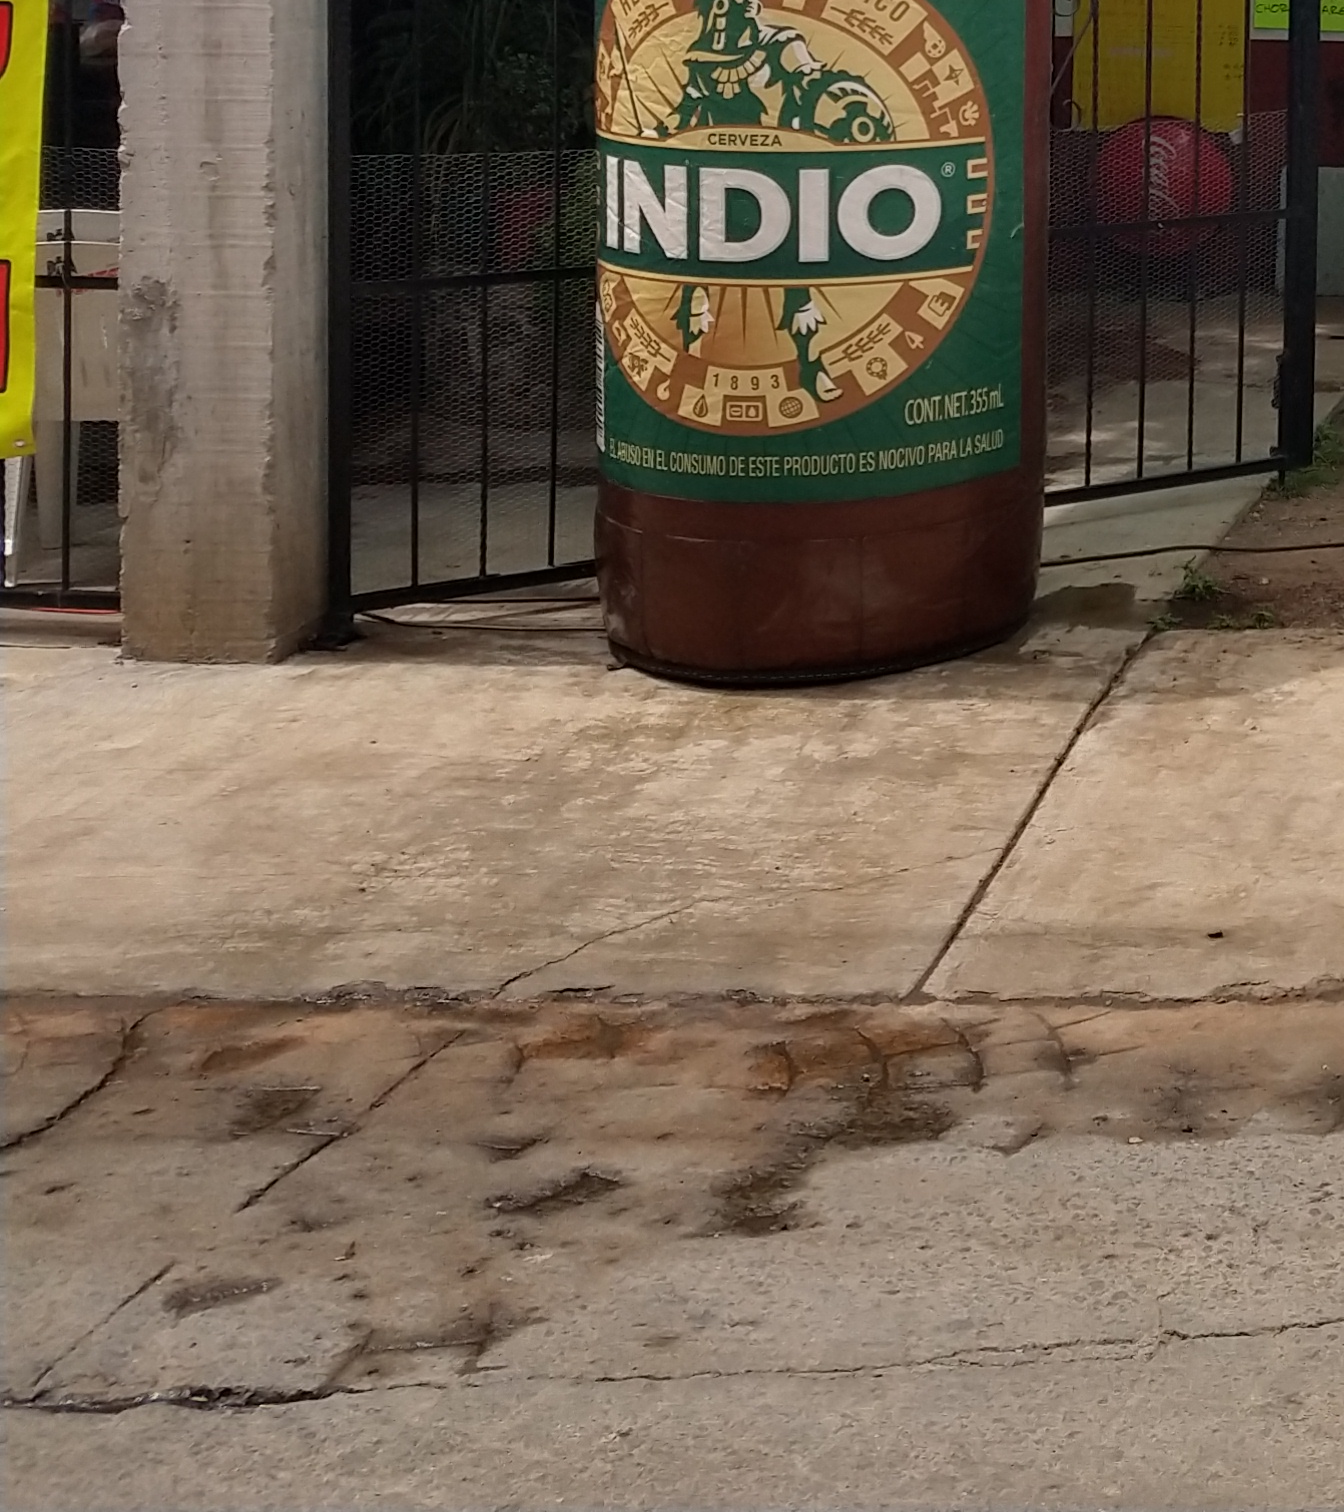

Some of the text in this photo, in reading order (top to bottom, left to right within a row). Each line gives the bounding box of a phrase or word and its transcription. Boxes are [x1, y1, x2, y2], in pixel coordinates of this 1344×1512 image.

[707, 133, 783, 148] CERVEZA
[605, 154, 942, 262] INDIO
[711, 372, 781, 392] 1893
[904, 383, 1005, 425] CONT. NET. 355 mL
[617, 441, 642, 466] ABUSO
[642, 446, 655, 469] EN
[656, 449, 668, 471] EL
[669, 451, 726, 476] CONSUMO
[729, 455, 746, 477] DE
[748, 456, 781, 477] ESTE
[784, 452, 856, 476] PRODUCTO
[859, 451, 876, 473] ES
[879, 445, 925, 470] NOCIVO
[928, 440, 958, 464] PARA
[959, 436, 973, 458] LA
[974, 428, 1004, 454] SALUD
